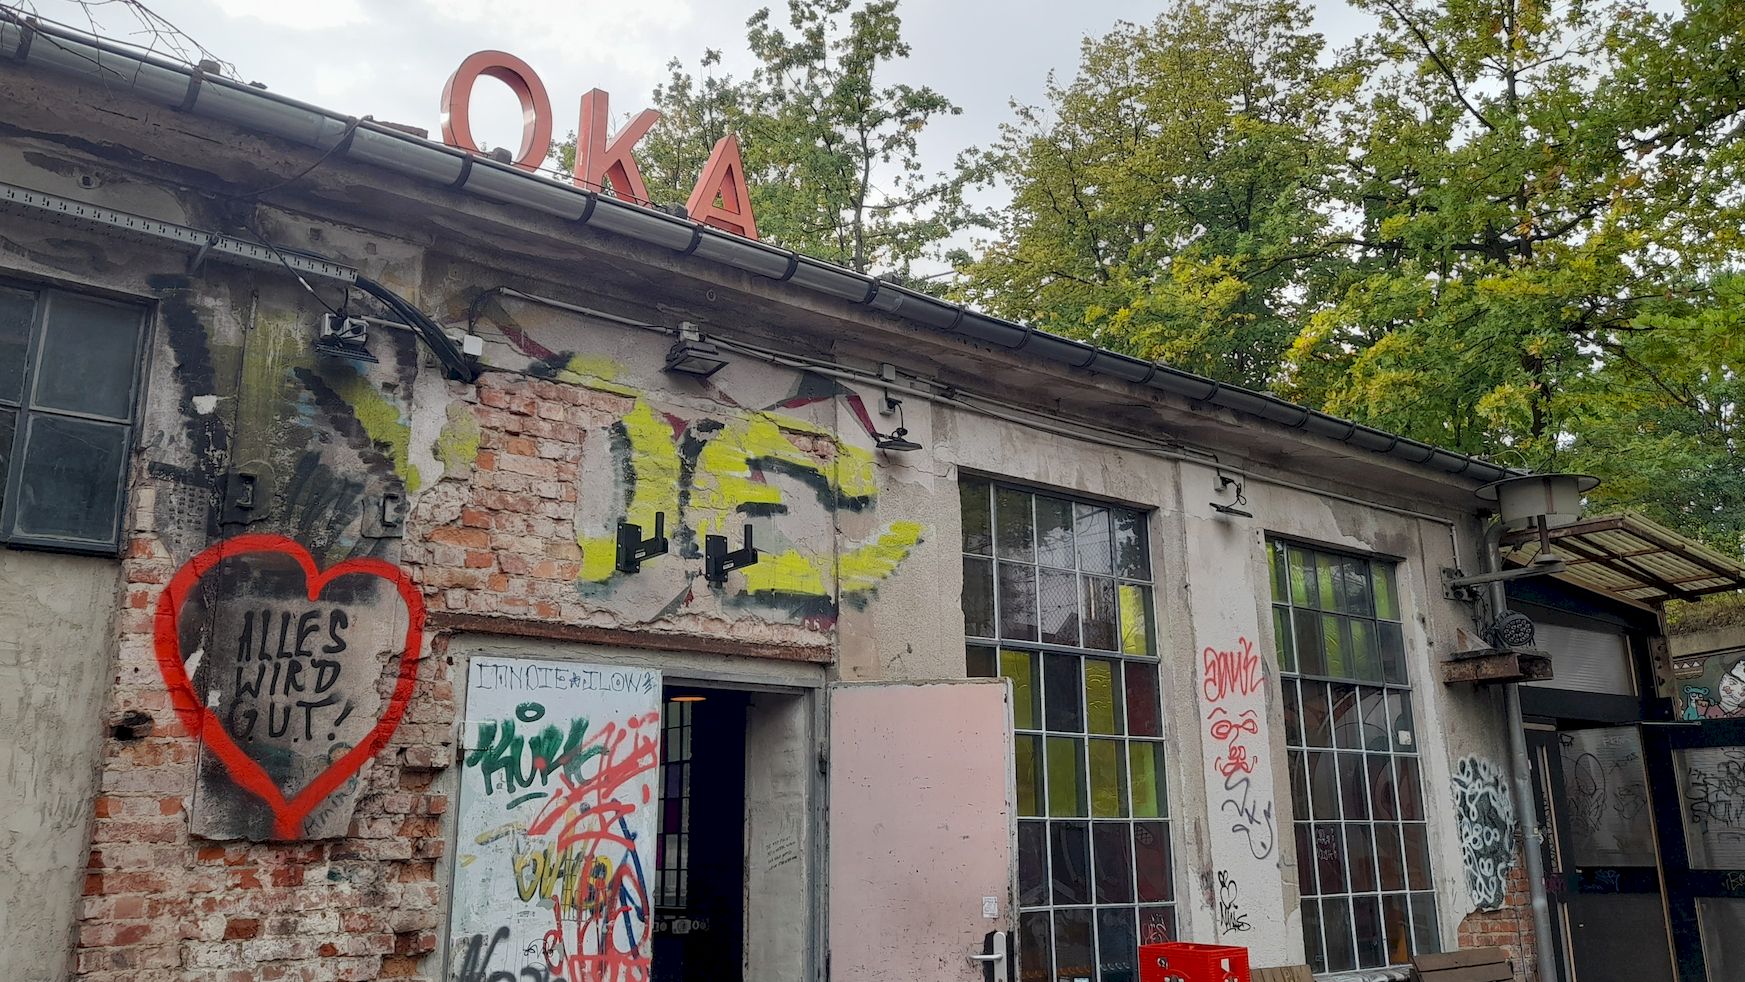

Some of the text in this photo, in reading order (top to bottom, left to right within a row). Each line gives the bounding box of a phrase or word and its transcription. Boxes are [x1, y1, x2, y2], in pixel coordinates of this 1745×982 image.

[440, 50, 759, 241] OKA
[237, 608, 349, 663] ALLES
[234, 658, 341, 699] WIRD
